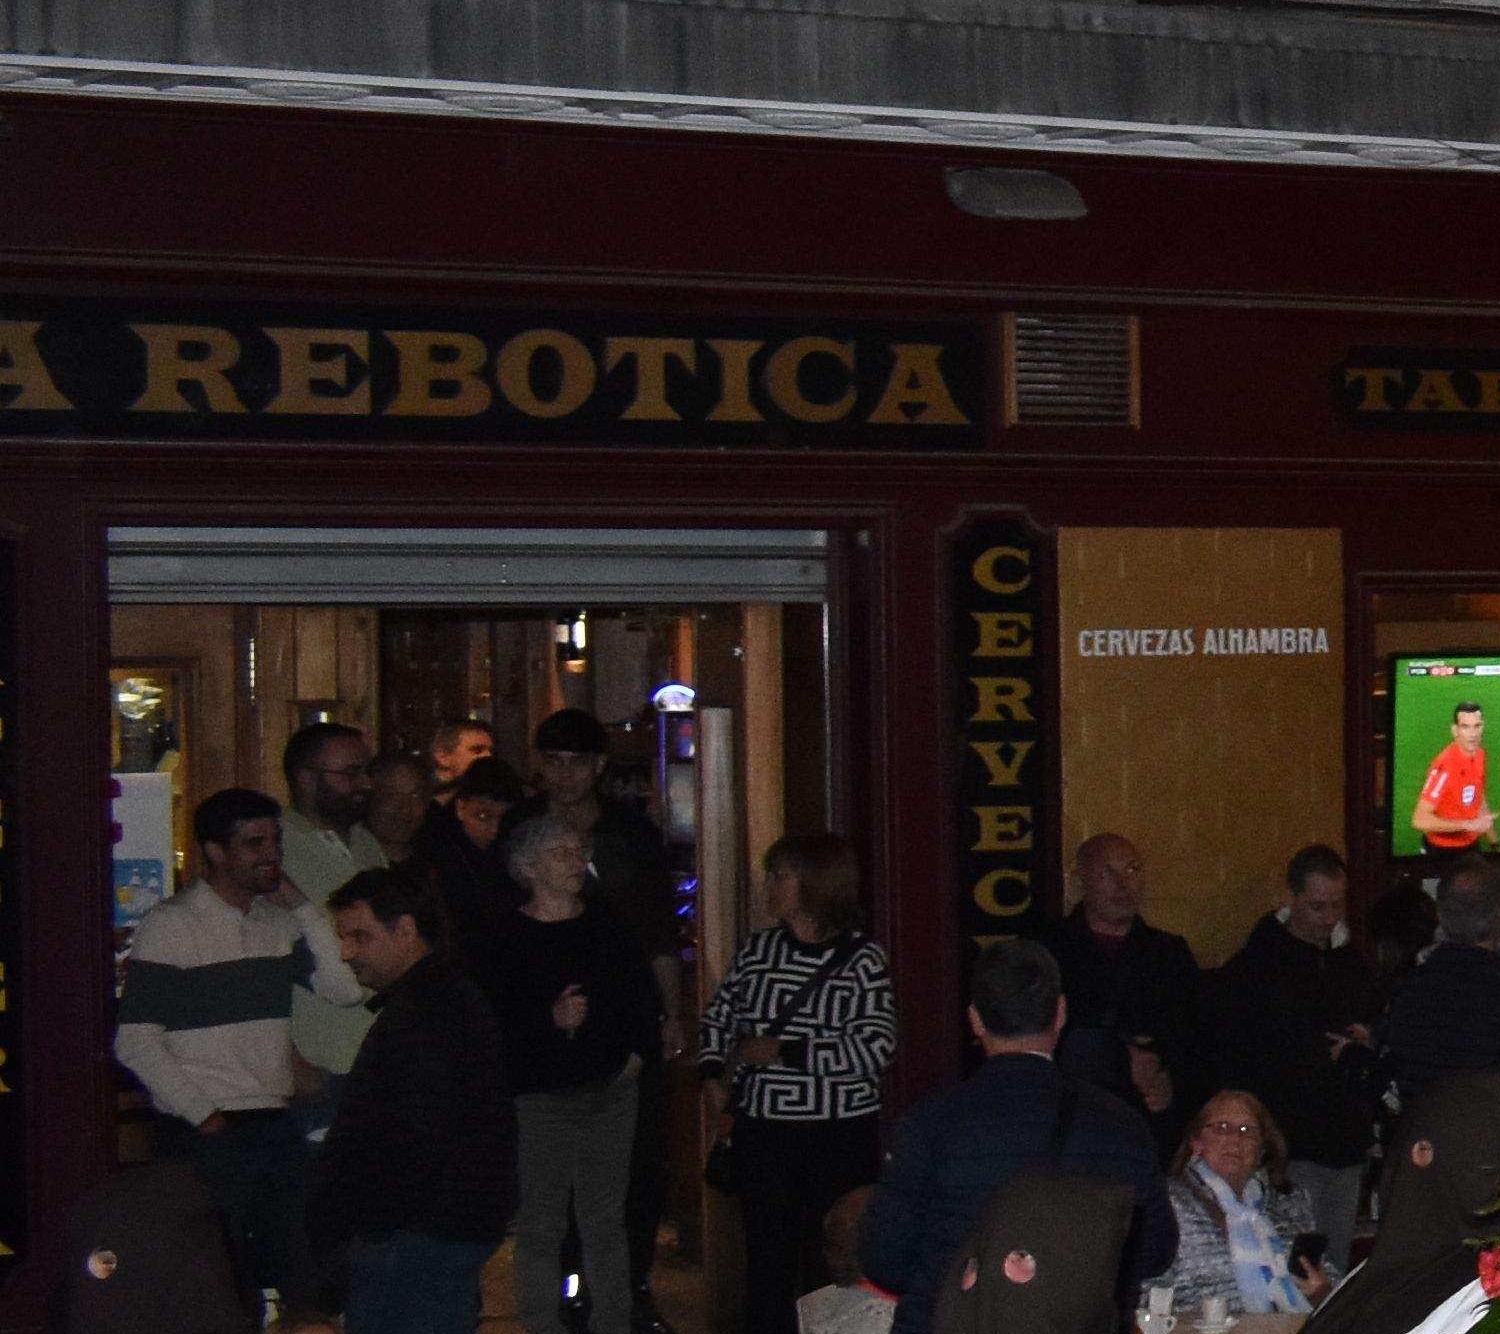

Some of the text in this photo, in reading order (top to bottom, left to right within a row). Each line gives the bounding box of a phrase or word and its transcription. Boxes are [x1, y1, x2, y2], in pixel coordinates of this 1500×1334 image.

[126, 323, 971, 425] REBOTICA
[1078, 627, 1329, 657] CERVEZAS ALHAMBRA
[968, 545, 1037, 955] CERVEC
